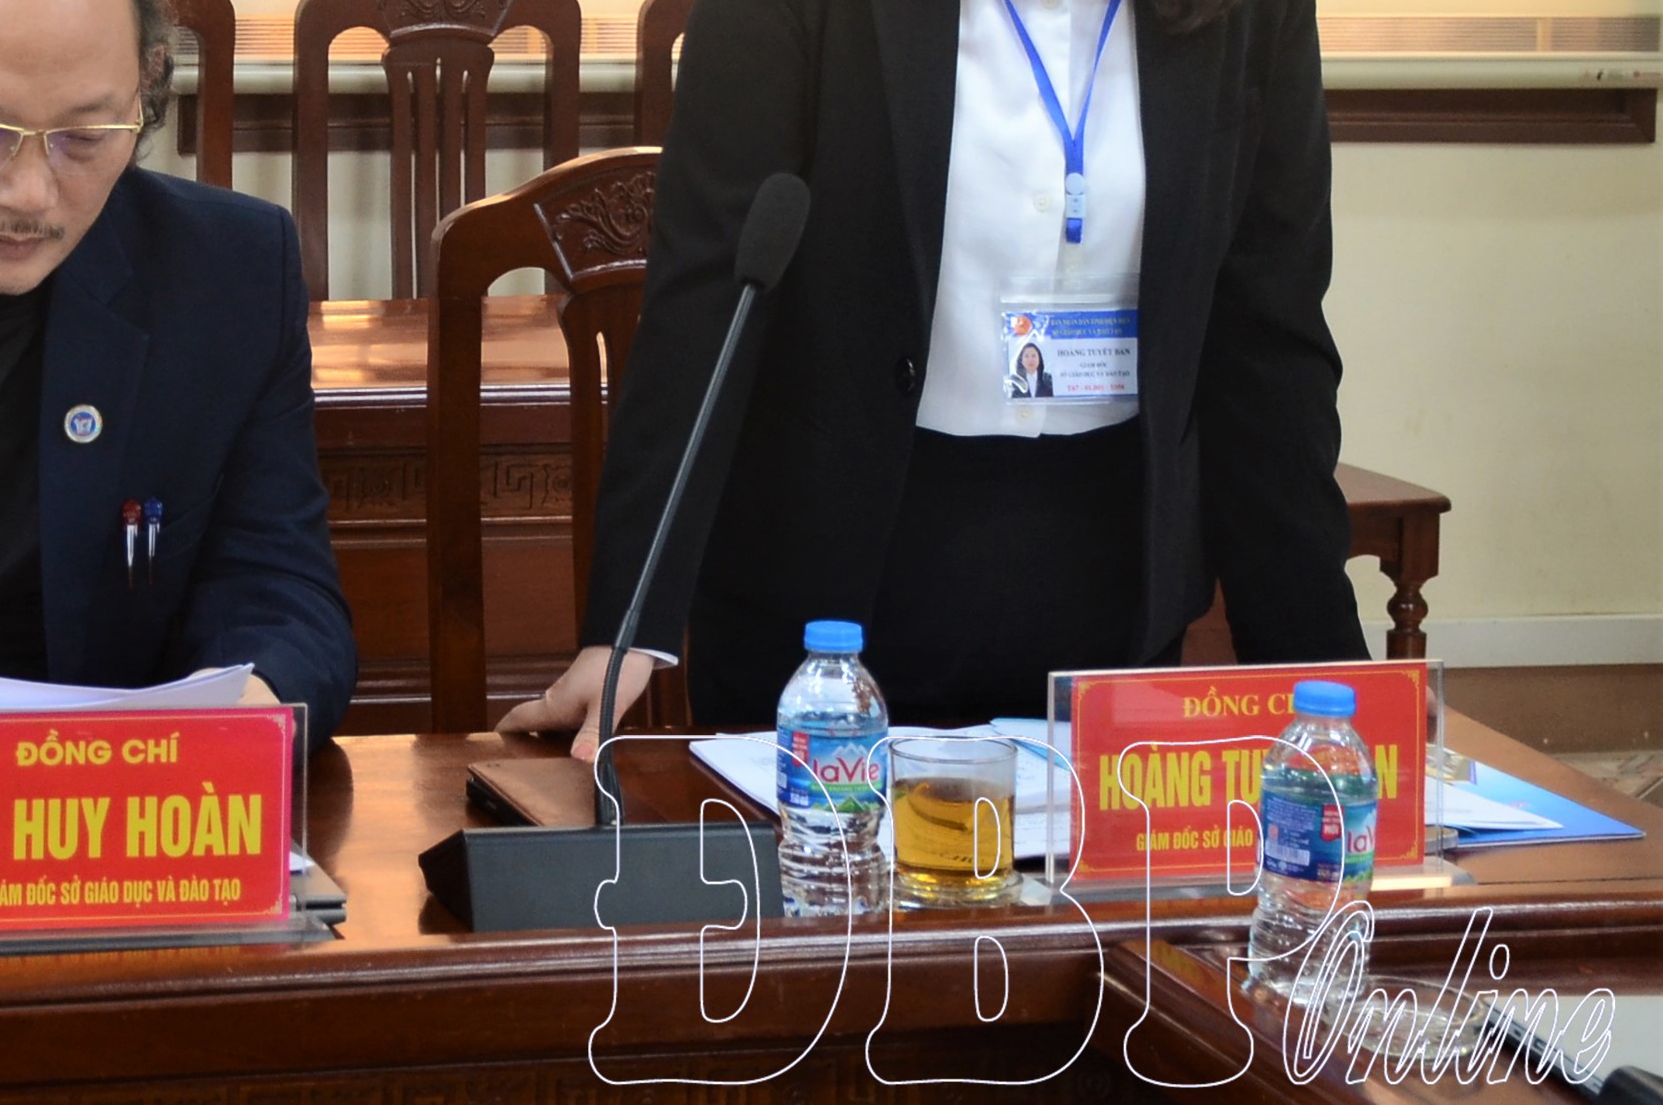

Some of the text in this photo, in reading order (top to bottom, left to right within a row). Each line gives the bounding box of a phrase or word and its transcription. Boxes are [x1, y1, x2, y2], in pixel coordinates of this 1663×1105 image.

[1183, 685, 1260, 719] ĐỒNG
[16, 728, 180, 766] ĐỒNG CHÍ
[1099, 742, 1212, 812] HOÀNG
[13, 797, 110, 861] HUY
[126, 781, 262, 859] HOÀN
[1135, 829, 1170, 852] GIÁM
[1173, 824, 1200, 850] ĐỐC
[1202, 824, 1221, 849] SỞ
[1223, 825, 1254, 848] GIÁO
[26, 874, 56, 907] ĐỐC
[60, 874, 82, 906] SỞ
[84, 876, 121, 905] GIÁO
[122, 879, 154, 910] DỤC
[156, 875, 177, 903] VÀ
[179, 874, 210, 904] ĐÀO
[213, 877, 242, 907] TẠO
